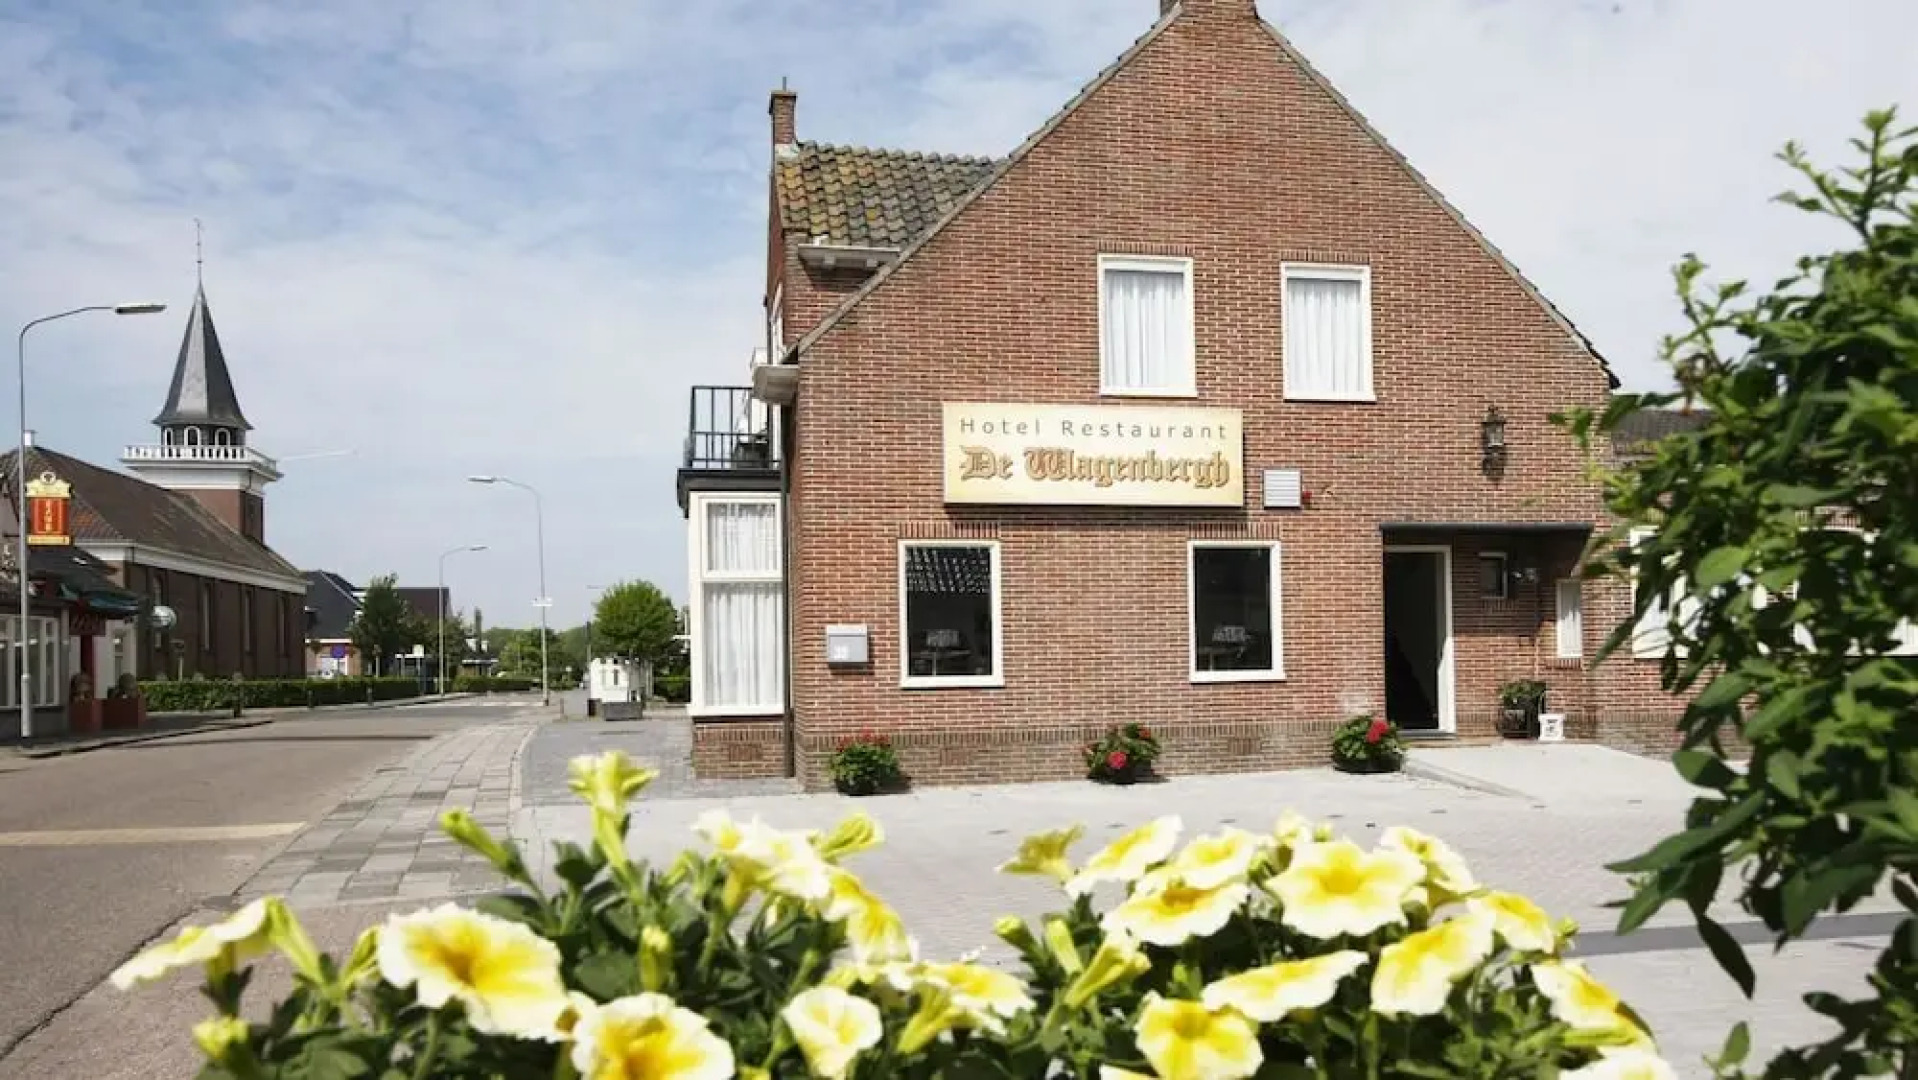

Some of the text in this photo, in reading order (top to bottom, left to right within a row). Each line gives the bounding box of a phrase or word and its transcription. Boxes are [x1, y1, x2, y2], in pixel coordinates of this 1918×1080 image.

[960, 418, 1228, 439] Hotel Restaurant
[959, 445, 1231, 489] De Wagenbergh
